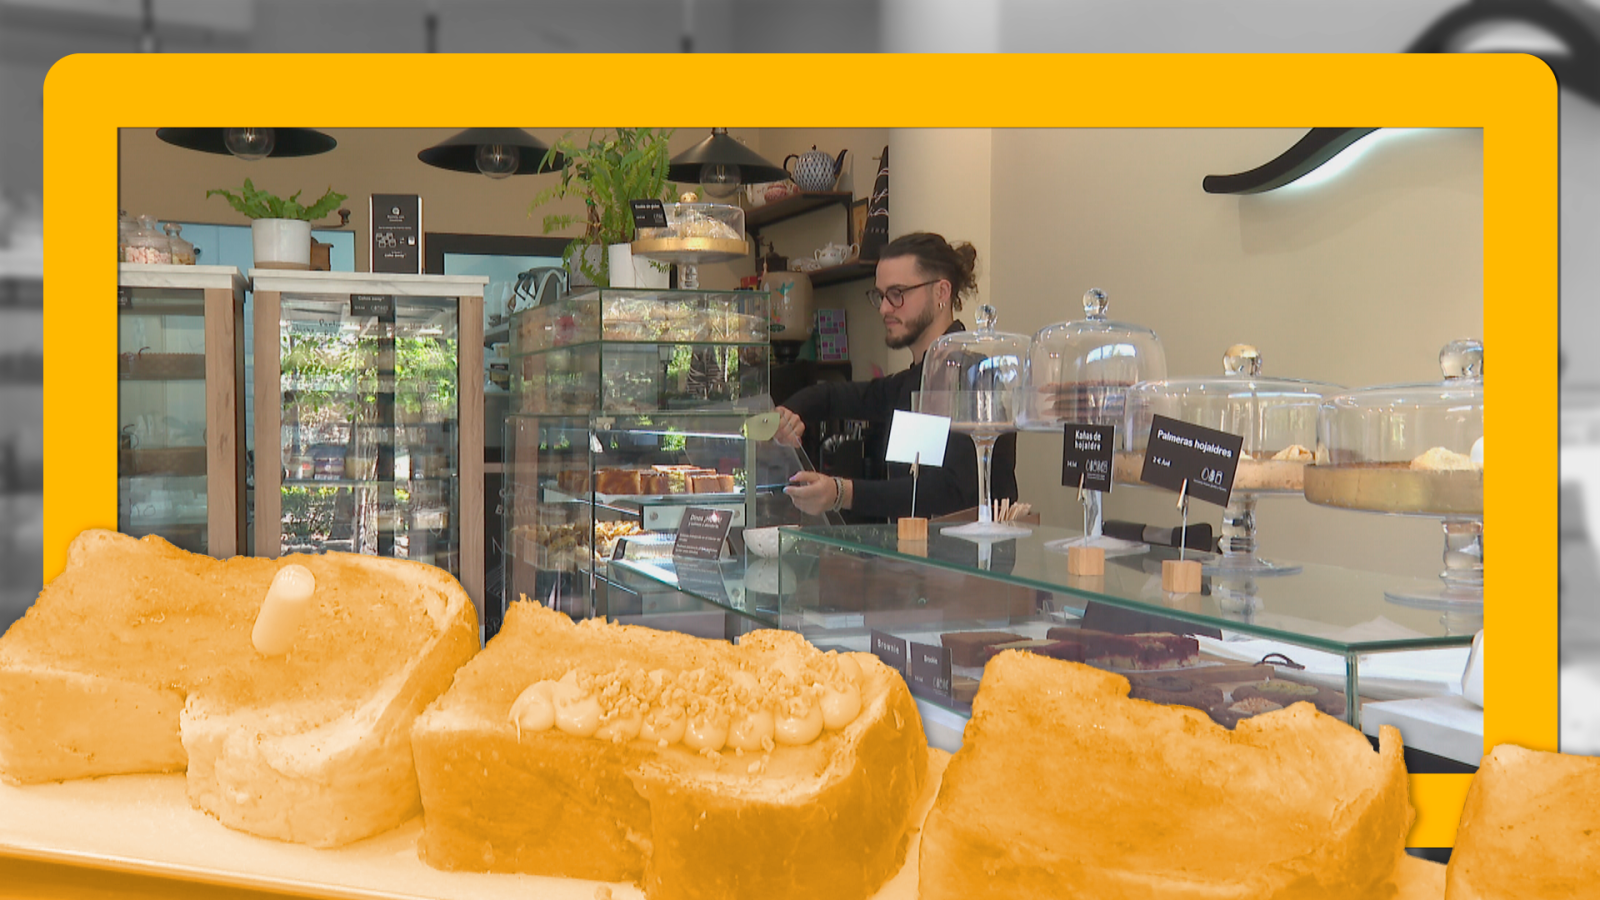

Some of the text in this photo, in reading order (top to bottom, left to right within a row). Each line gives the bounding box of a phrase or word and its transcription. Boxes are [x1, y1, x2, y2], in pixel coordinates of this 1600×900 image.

[1075, 430, 1102, 441] Kañas de
[1075, 440, 1101, 452] hojaldre
[1157, 428, 1233, 458] Palmeras hojaldres
[877, 638, 900, 655] Brownie
